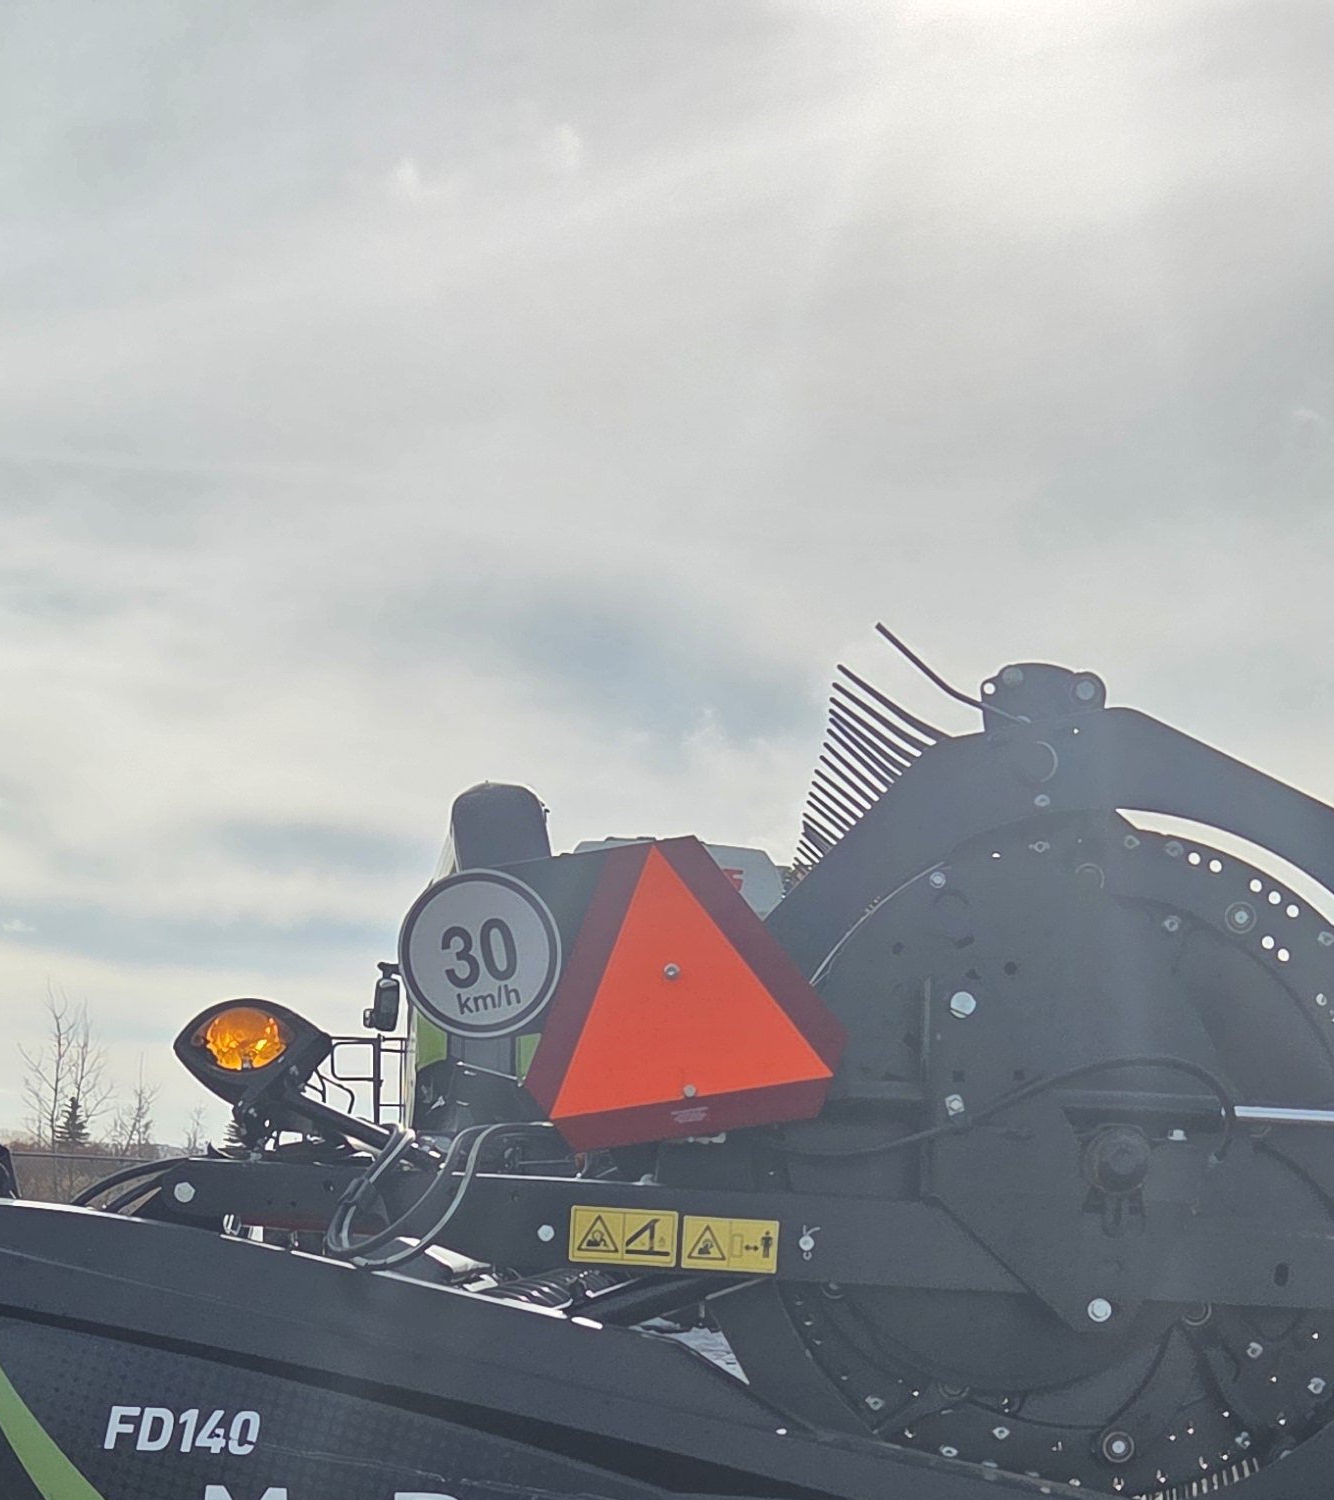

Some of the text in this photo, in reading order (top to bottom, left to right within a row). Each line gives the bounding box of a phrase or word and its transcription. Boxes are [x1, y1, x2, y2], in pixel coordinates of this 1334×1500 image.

[441, 917, 517, 989] 30
[456, 983, 521, 1015] km/h
[103, 1405, 261, 1455] FD140
